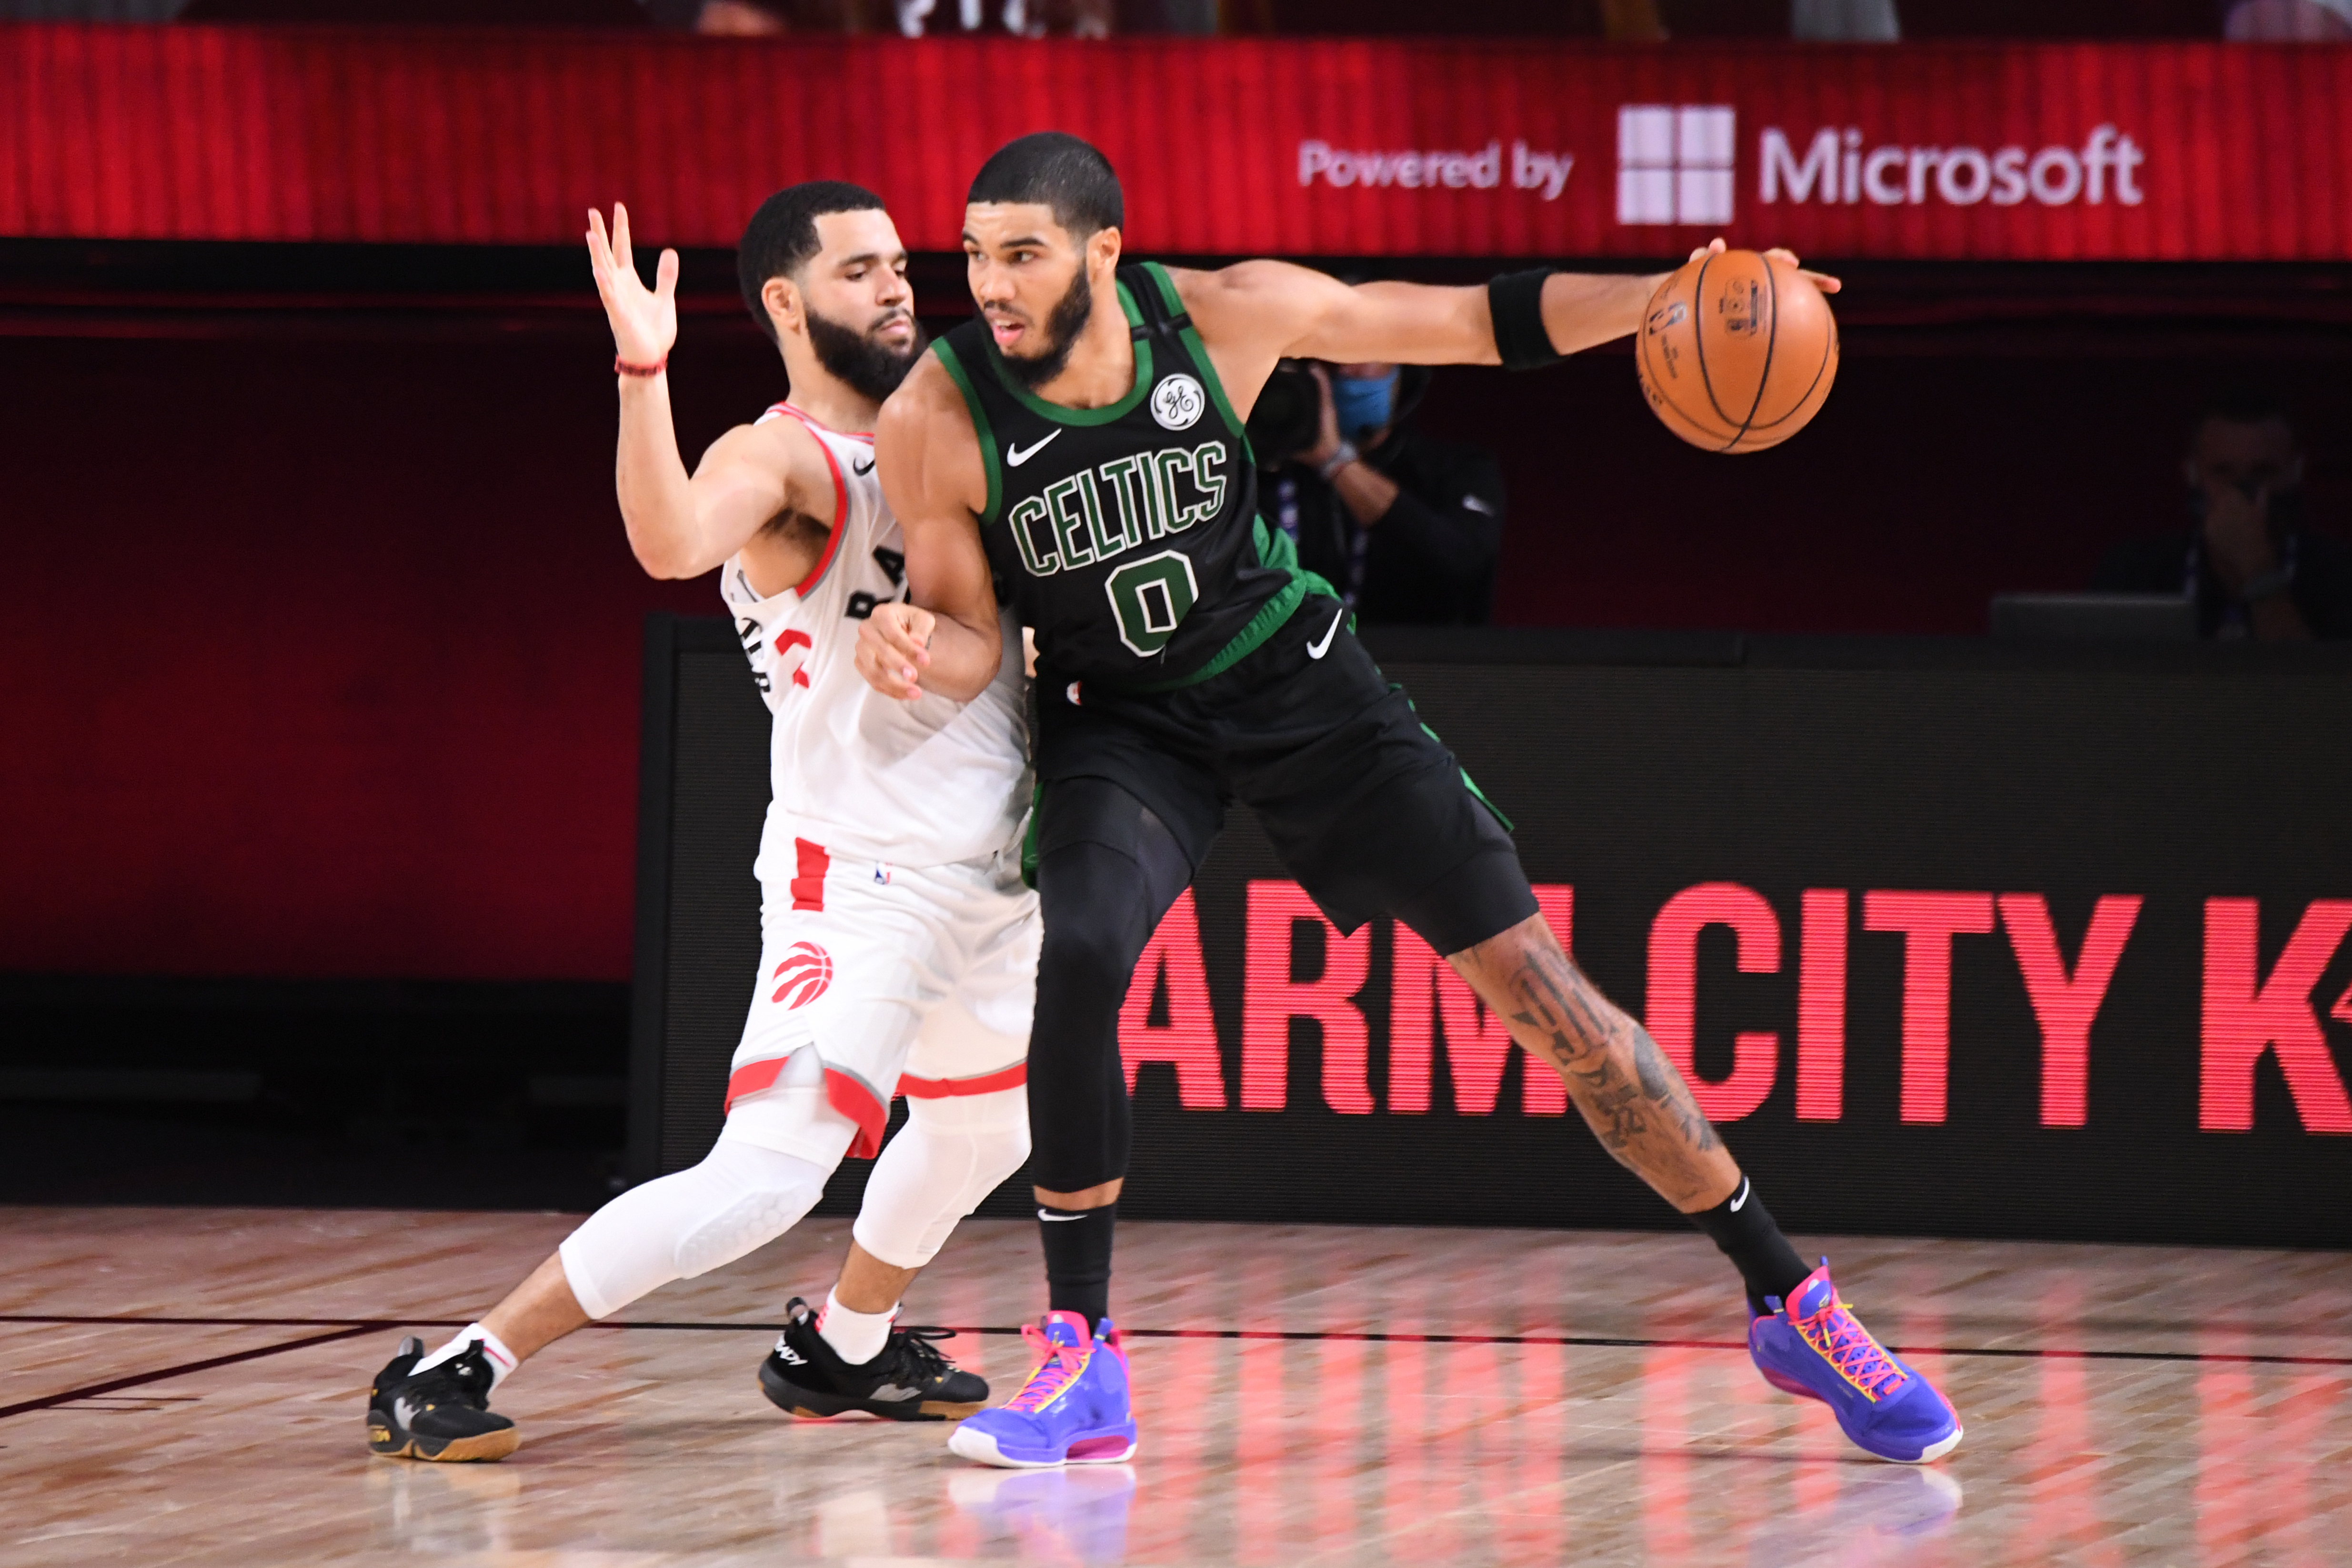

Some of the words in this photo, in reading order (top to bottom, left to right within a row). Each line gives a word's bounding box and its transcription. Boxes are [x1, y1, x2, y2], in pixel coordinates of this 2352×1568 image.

[1298, 141, 1502, 188] Powered
[1512, 141, 1574, 201] by
[1759, 123, 2144, 205] Microsoft
[1008, 441, 1227, 577] CELTICS
[1105, 550, 1199, 657] 0
[1117, 879, 1574, 1116] ARM
[1643, 881, 2144, 1130] CITY
